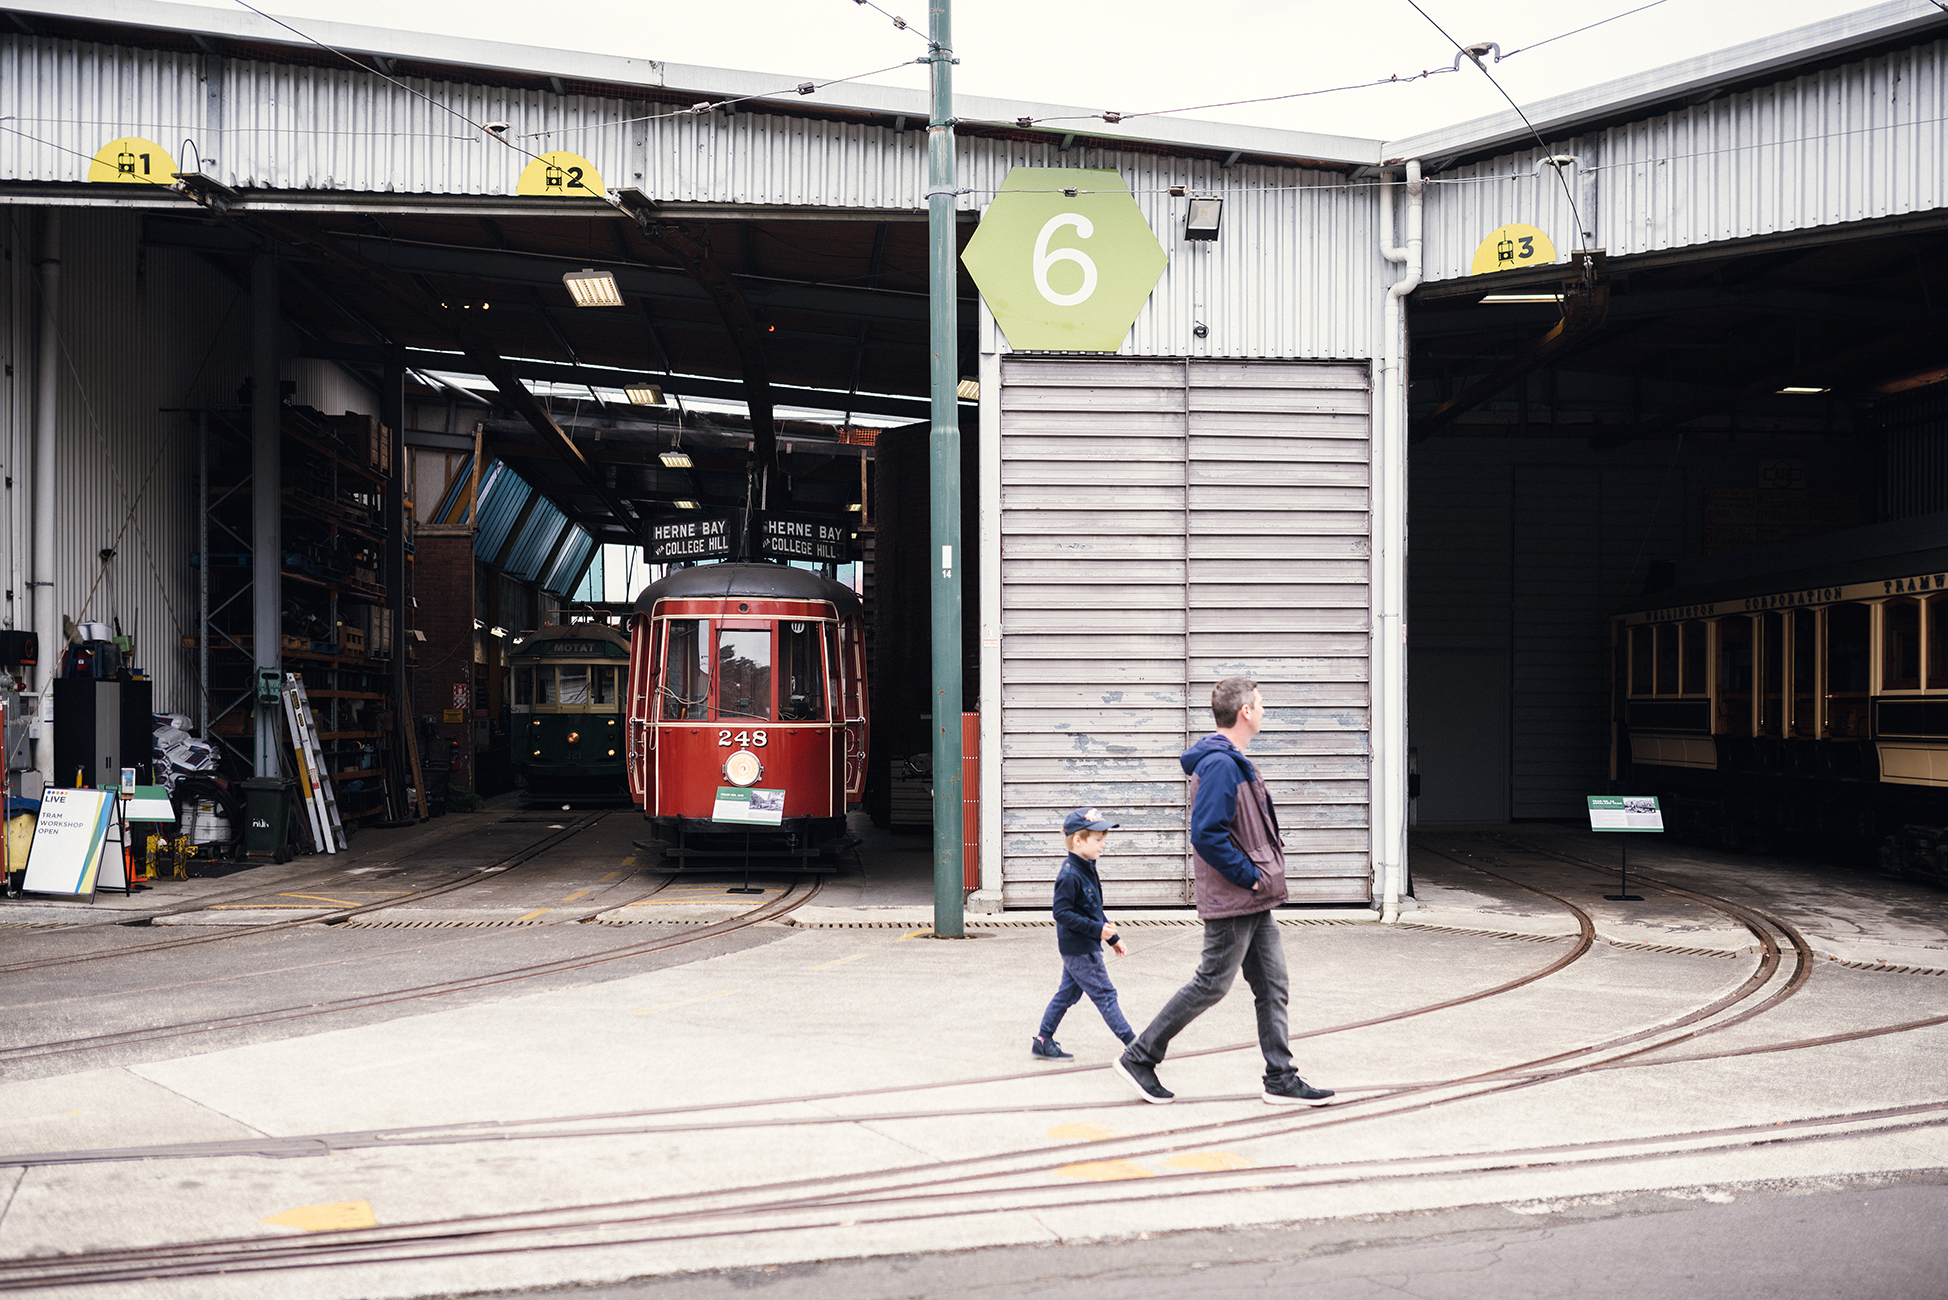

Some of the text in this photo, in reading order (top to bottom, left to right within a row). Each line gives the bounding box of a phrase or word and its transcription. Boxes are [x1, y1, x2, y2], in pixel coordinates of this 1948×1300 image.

[139, 153, 151, 175] 1
[567, 166, 584, 188] 2
[1518, 235, 1535, 259] 3
[1033, 213, 1098, 307] 6
[655, 520, 726, 540] HERNE BAY
[768, 520, 842, 541] HERNE BAY
[655, 536, 729, 556] VIA COLLEGE HILL
[771, 537, 813, 555] COLLEGE
[816, 543, 836, 558] HILL
[941, 569, 952, 579] 14
[1644, 574, 1946, 622] WELLINGTON CORPORATION TRAMW
[553, 643, 595, 652] MOTAT
[718, 729, 768, 747] 248
[565, 750, 582, 760] 321
[45, 795, 67, 803] LIVE
[40, 820, 84, 828] WORKSHOP
